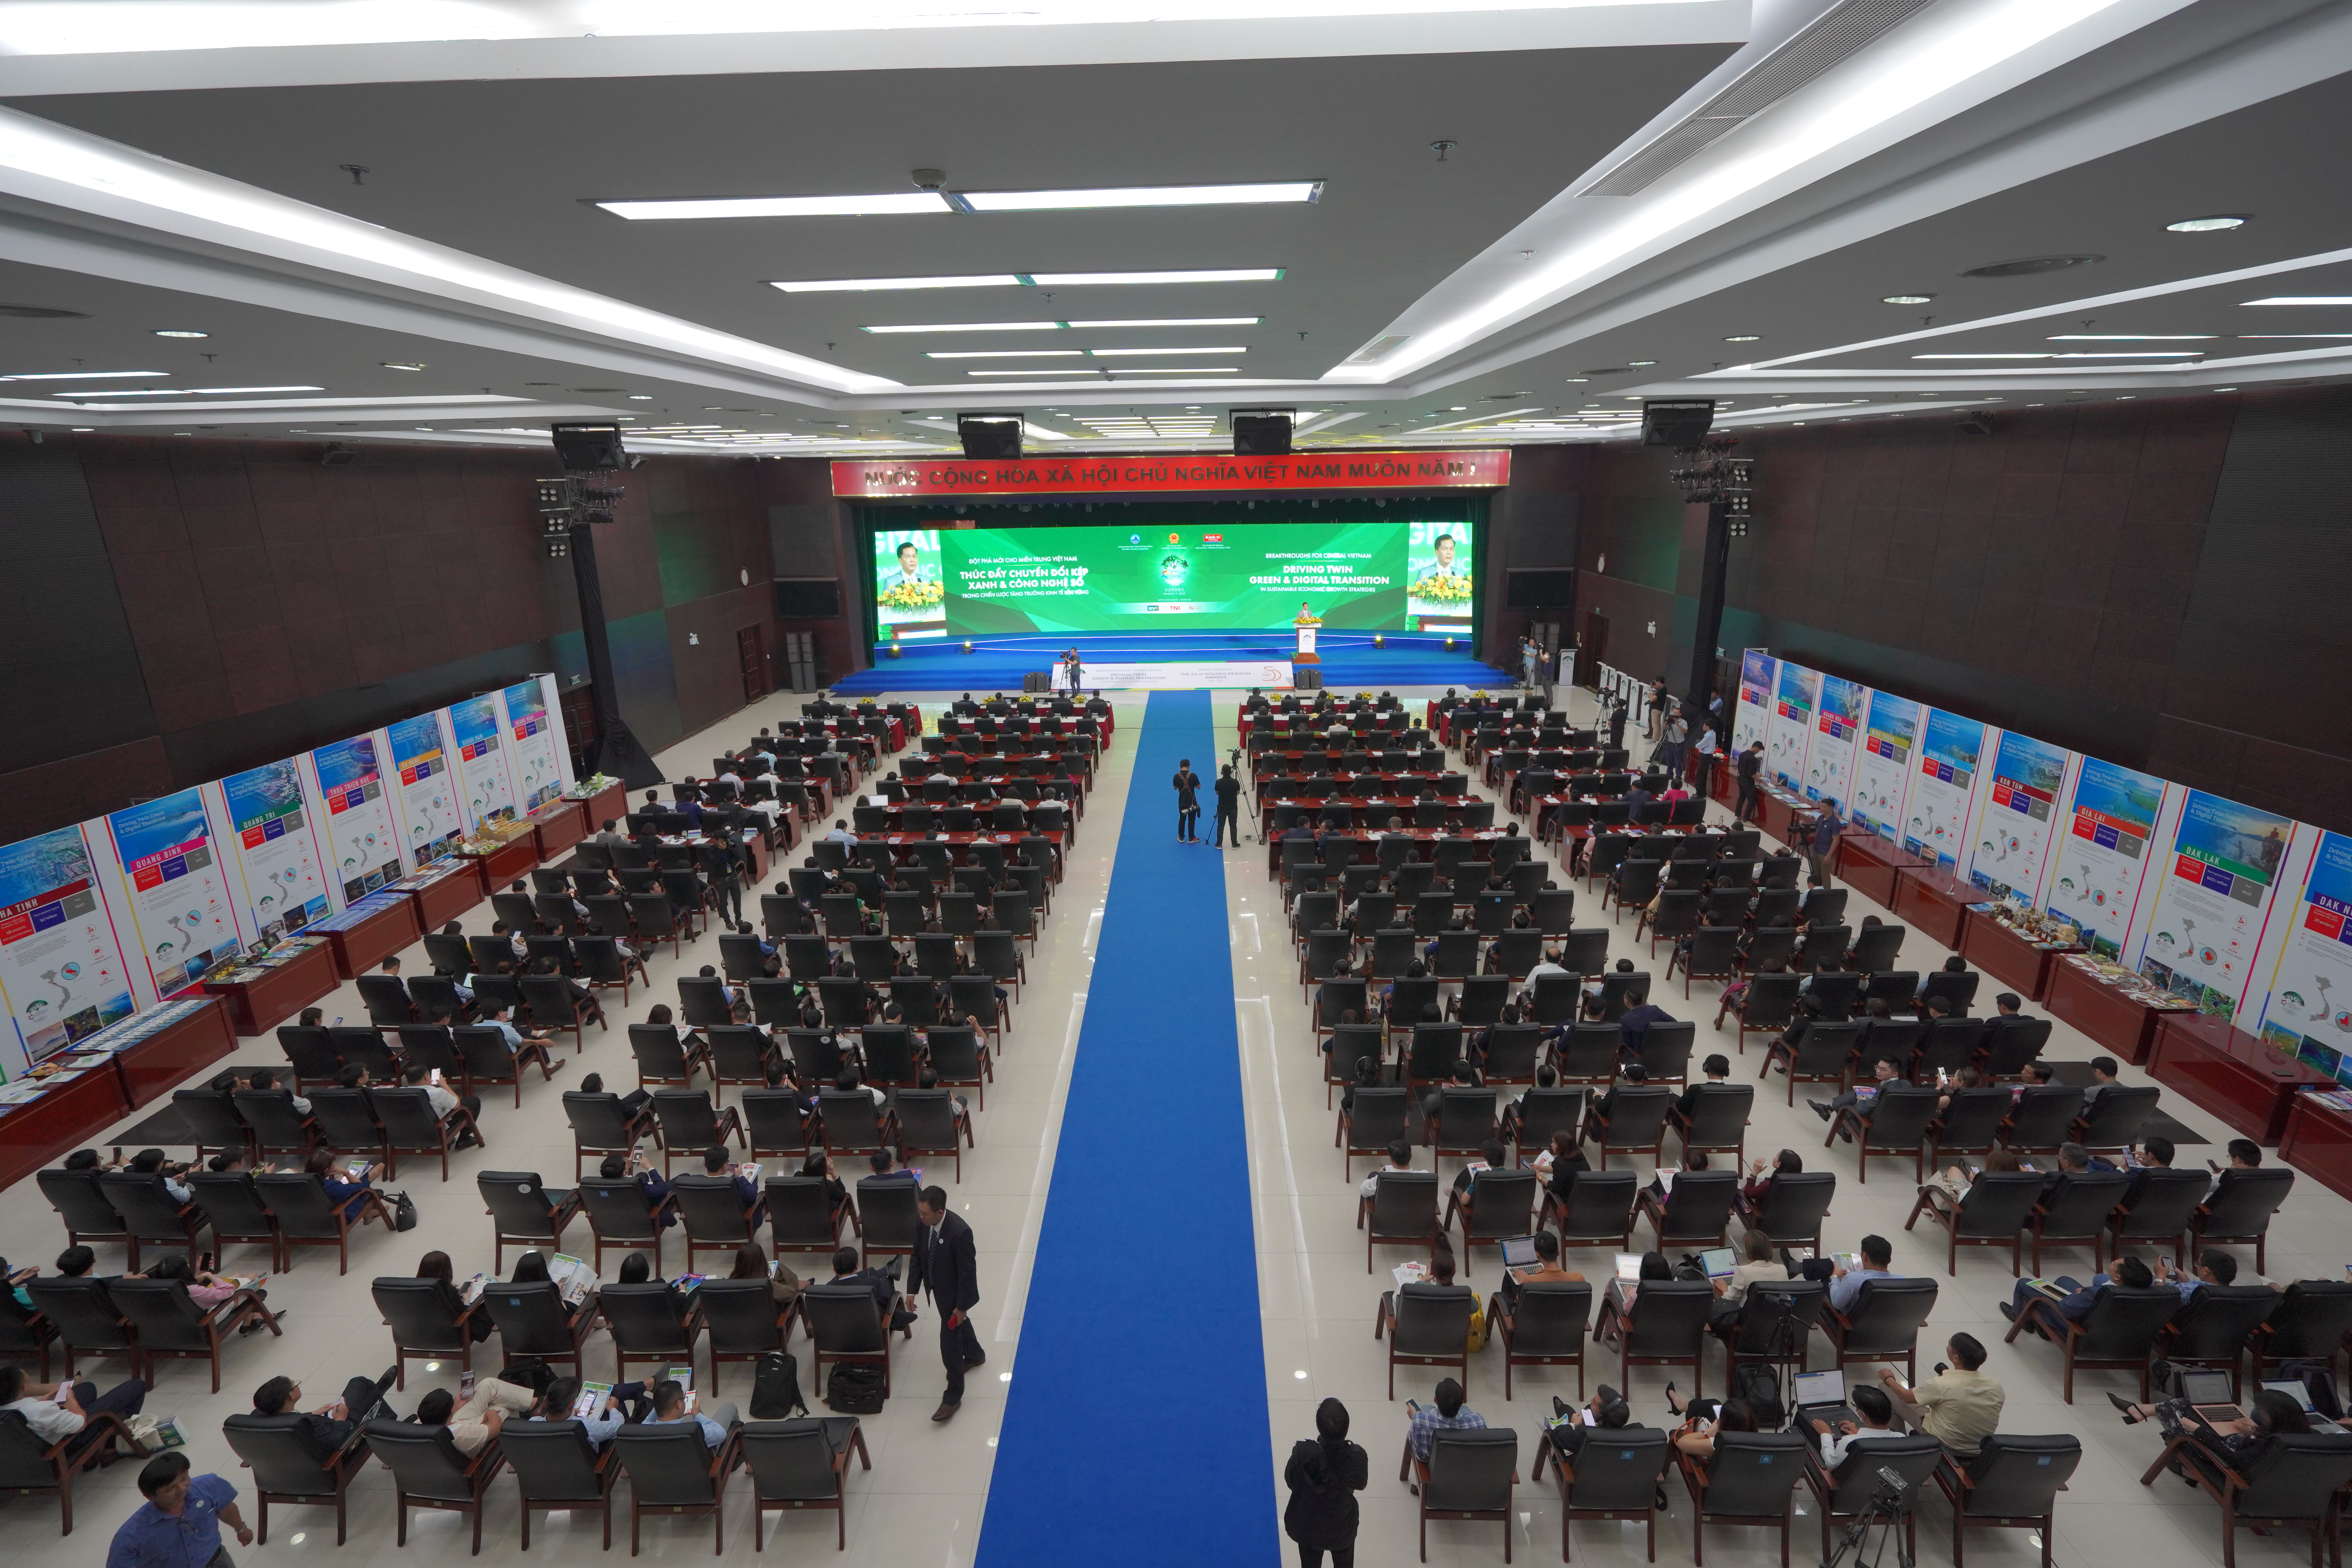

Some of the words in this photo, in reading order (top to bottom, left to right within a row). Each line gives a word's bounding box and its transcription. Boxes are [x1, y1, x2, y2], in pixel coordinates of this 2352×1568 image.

[865, 466, 922, 486] NƯỚC
[929, 466, 989, 488] CỘNG
[996, 465, 1040, 484] HÒA
[1047, 465, 1075, 483] XÃ
[1082, 463, 1117, 486] HỘI
[1125, 461, 1167, 481] CHỦ
[1176, 462, 1240, 481] NGHĨA
[1245, 461, 1289, 483] VIỆT
[1297, 464, 1341, 479] NAM
[1349, 459, 1410, 477] MUÔN
[1418, 459, 1464, 477] NĂM
[960, 569, 986, 579] THÚC
[988, 567, 1007, 578] ĐẨY
[1009, 566, 1048, 577] CHUYỂN
[1051, 565, 1069, 576] ĐỔI
[1071, 566, 1088, 576] KÉP
[1283, 565, 1325, 573] DRIVING
[1326, 565, 1353, 573] TWIN
[1009, 578, 1038, 588] CÔNG
[1041, 577, 1068, 588] NGHỆ
[1070, 576, 1084, 586] SỐ
[330, 786, 343, 795] THUA
[344, 780, 359, 790] THIEN
[2000, 777, 2010, 786] KON
[2012, 782, 2023, 790] TUM
[2081, 808, 2091, 817] GIA
[2094, 813, 2105, 822] LAI
[2192, 802, 2210, 813] Driving
[2225, 813, 2241, 822] Green
[118, 819, 136, 828] Driving
[243, 816, 263, 828] QUANG
[2195, 810, 2212, 820] Digital
[2213, 816, 2239, 828] Transition
[125, 824, 141, 833] Digital
[136, 853, 161, 868] QUANG
[163, 846, 181, 858] BINH
[2186, 847, 2201, 858] DAK
[2204, 853, 2220, 865] LAK
[2328, 847, 2350, 860] Driving
[1, 907, 12, 919] HA
[16, 898, 37, 913] TINH
[2320, 897, 2338, 910] DAK
[2319, 920, 2334, 929] projects
